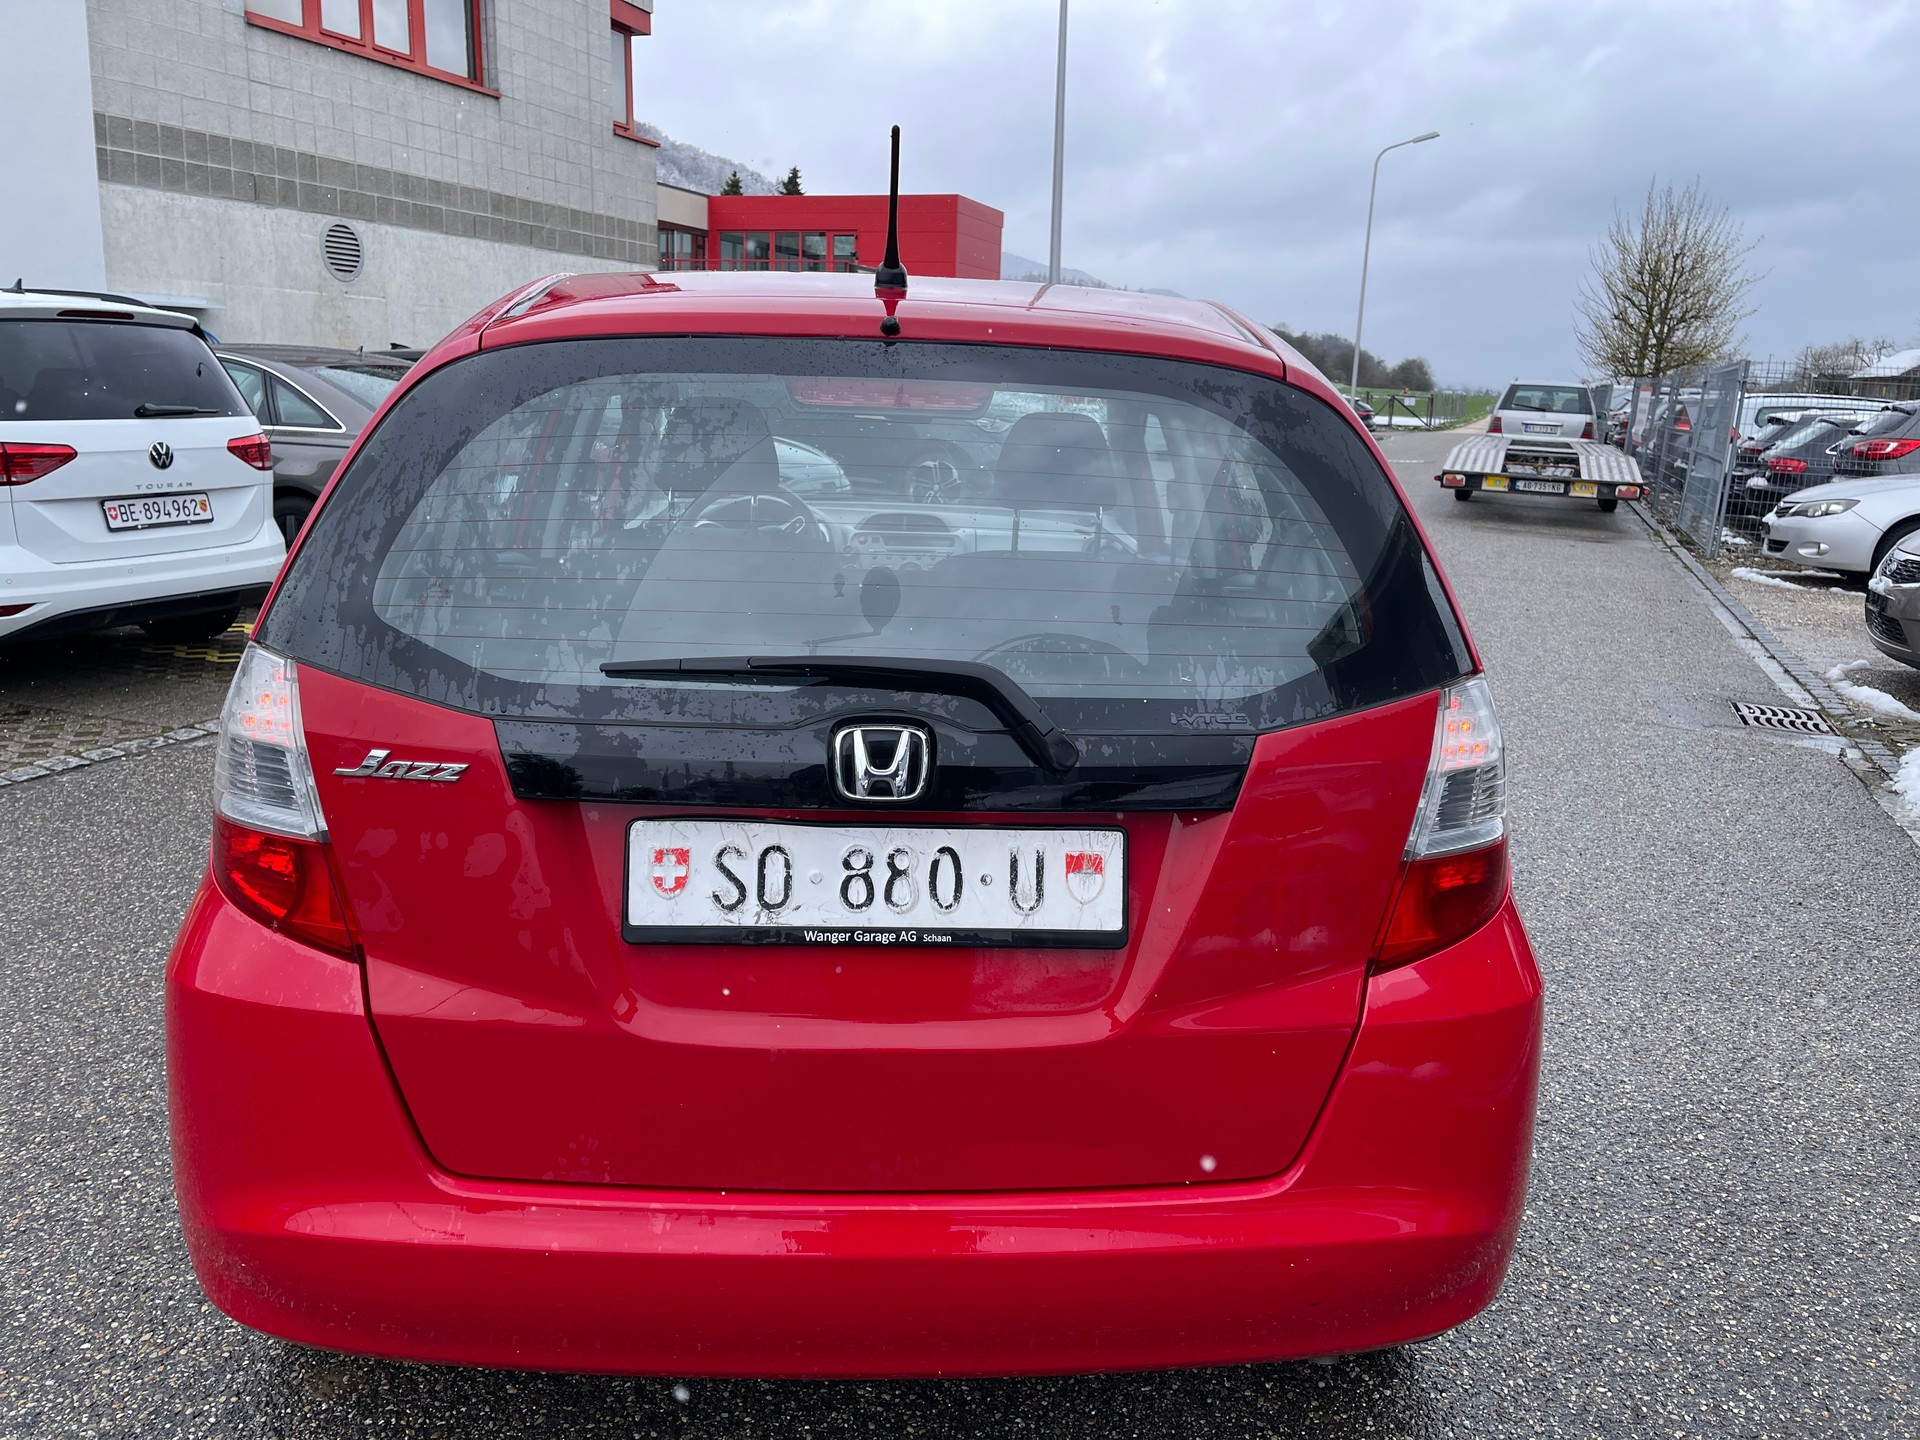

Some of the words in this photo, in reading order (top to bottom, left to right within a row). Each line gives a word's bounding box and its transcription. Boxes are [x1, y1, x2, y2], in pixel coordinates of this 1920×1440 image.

[136, 482, 193, 490] TOURAN
[804, 930, 851, 944] Wanger
[854, 930, 897, 944] Garage
[899, 930, 917, 942] AG
[922, 933, 952, 943] Schaan
